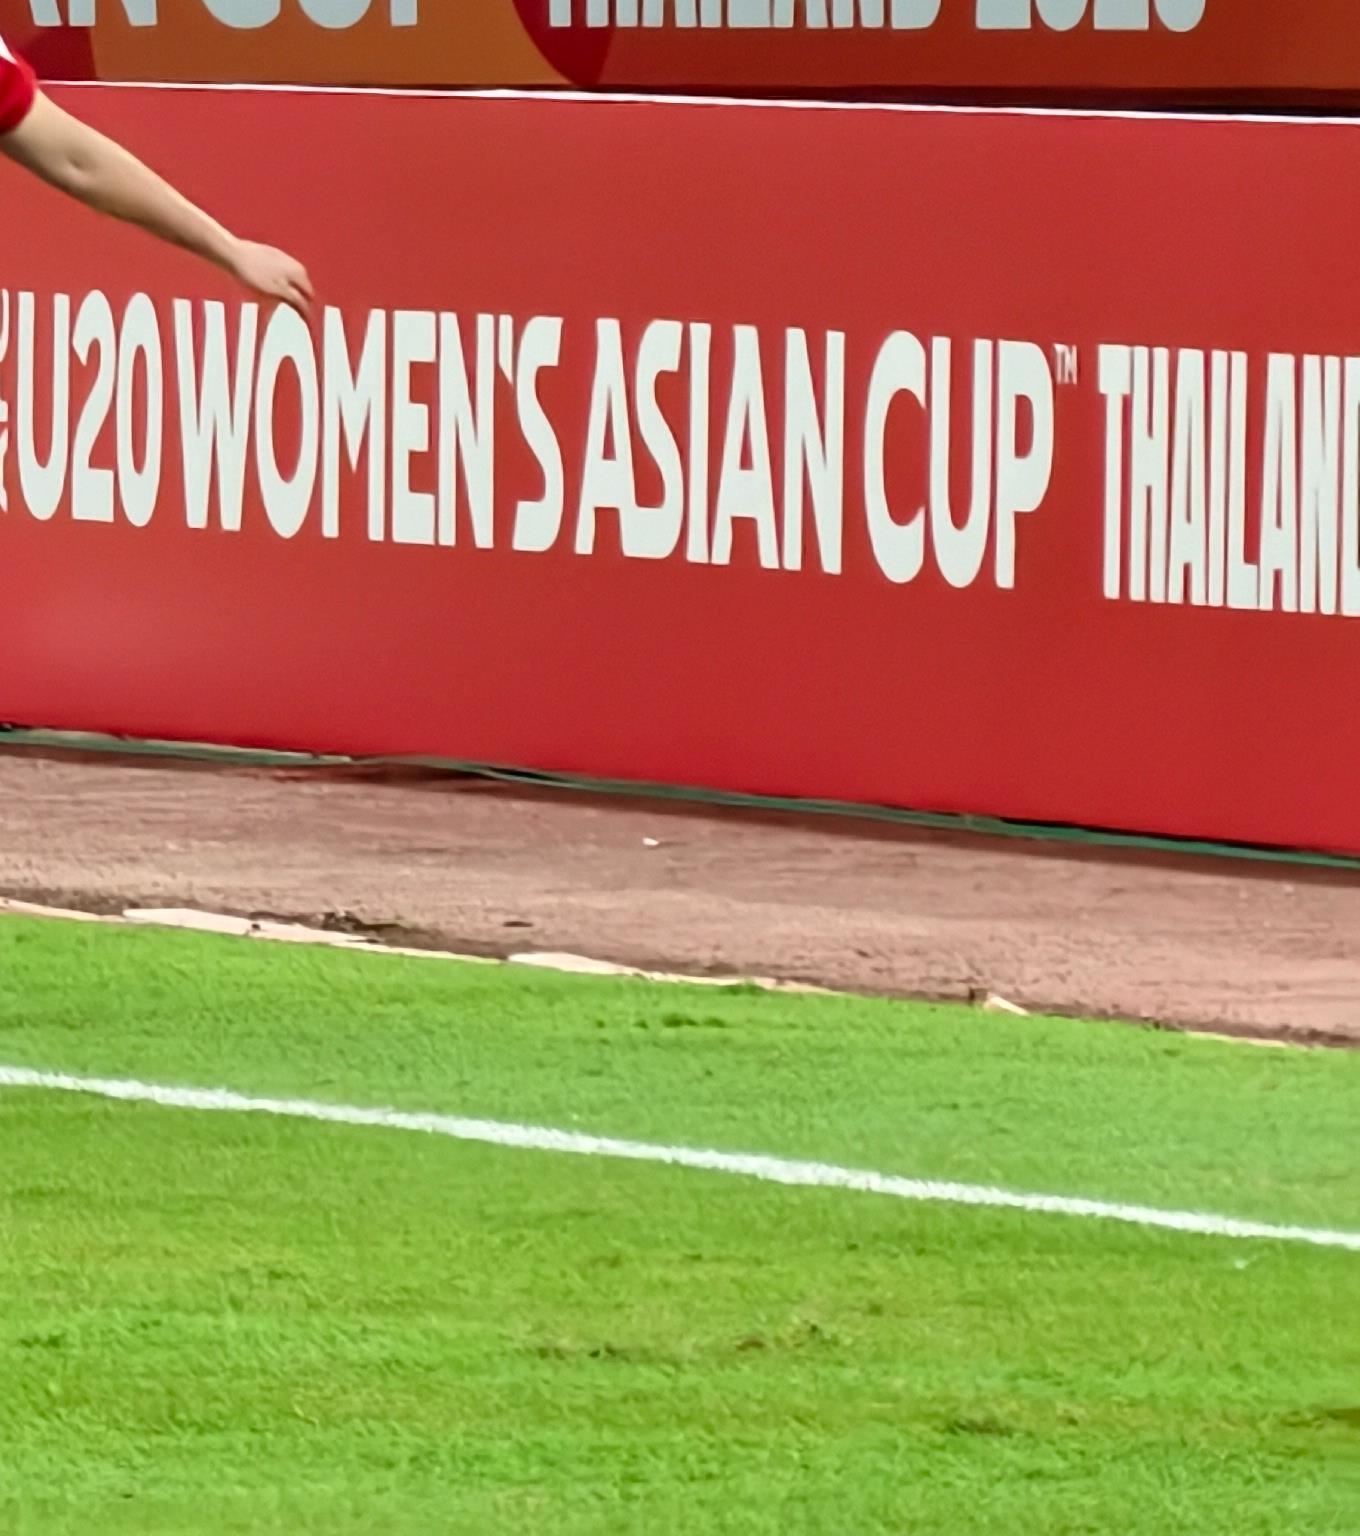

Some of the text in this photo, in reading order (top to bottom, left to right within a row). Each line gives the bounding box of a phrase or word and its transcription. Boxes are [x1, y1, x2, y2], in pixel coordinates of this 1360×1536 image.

[16, 289, 164, 528] U20
[172, 297, 565, 553] WOMEN'S
[574, 317, 846, 575] ASIAN
